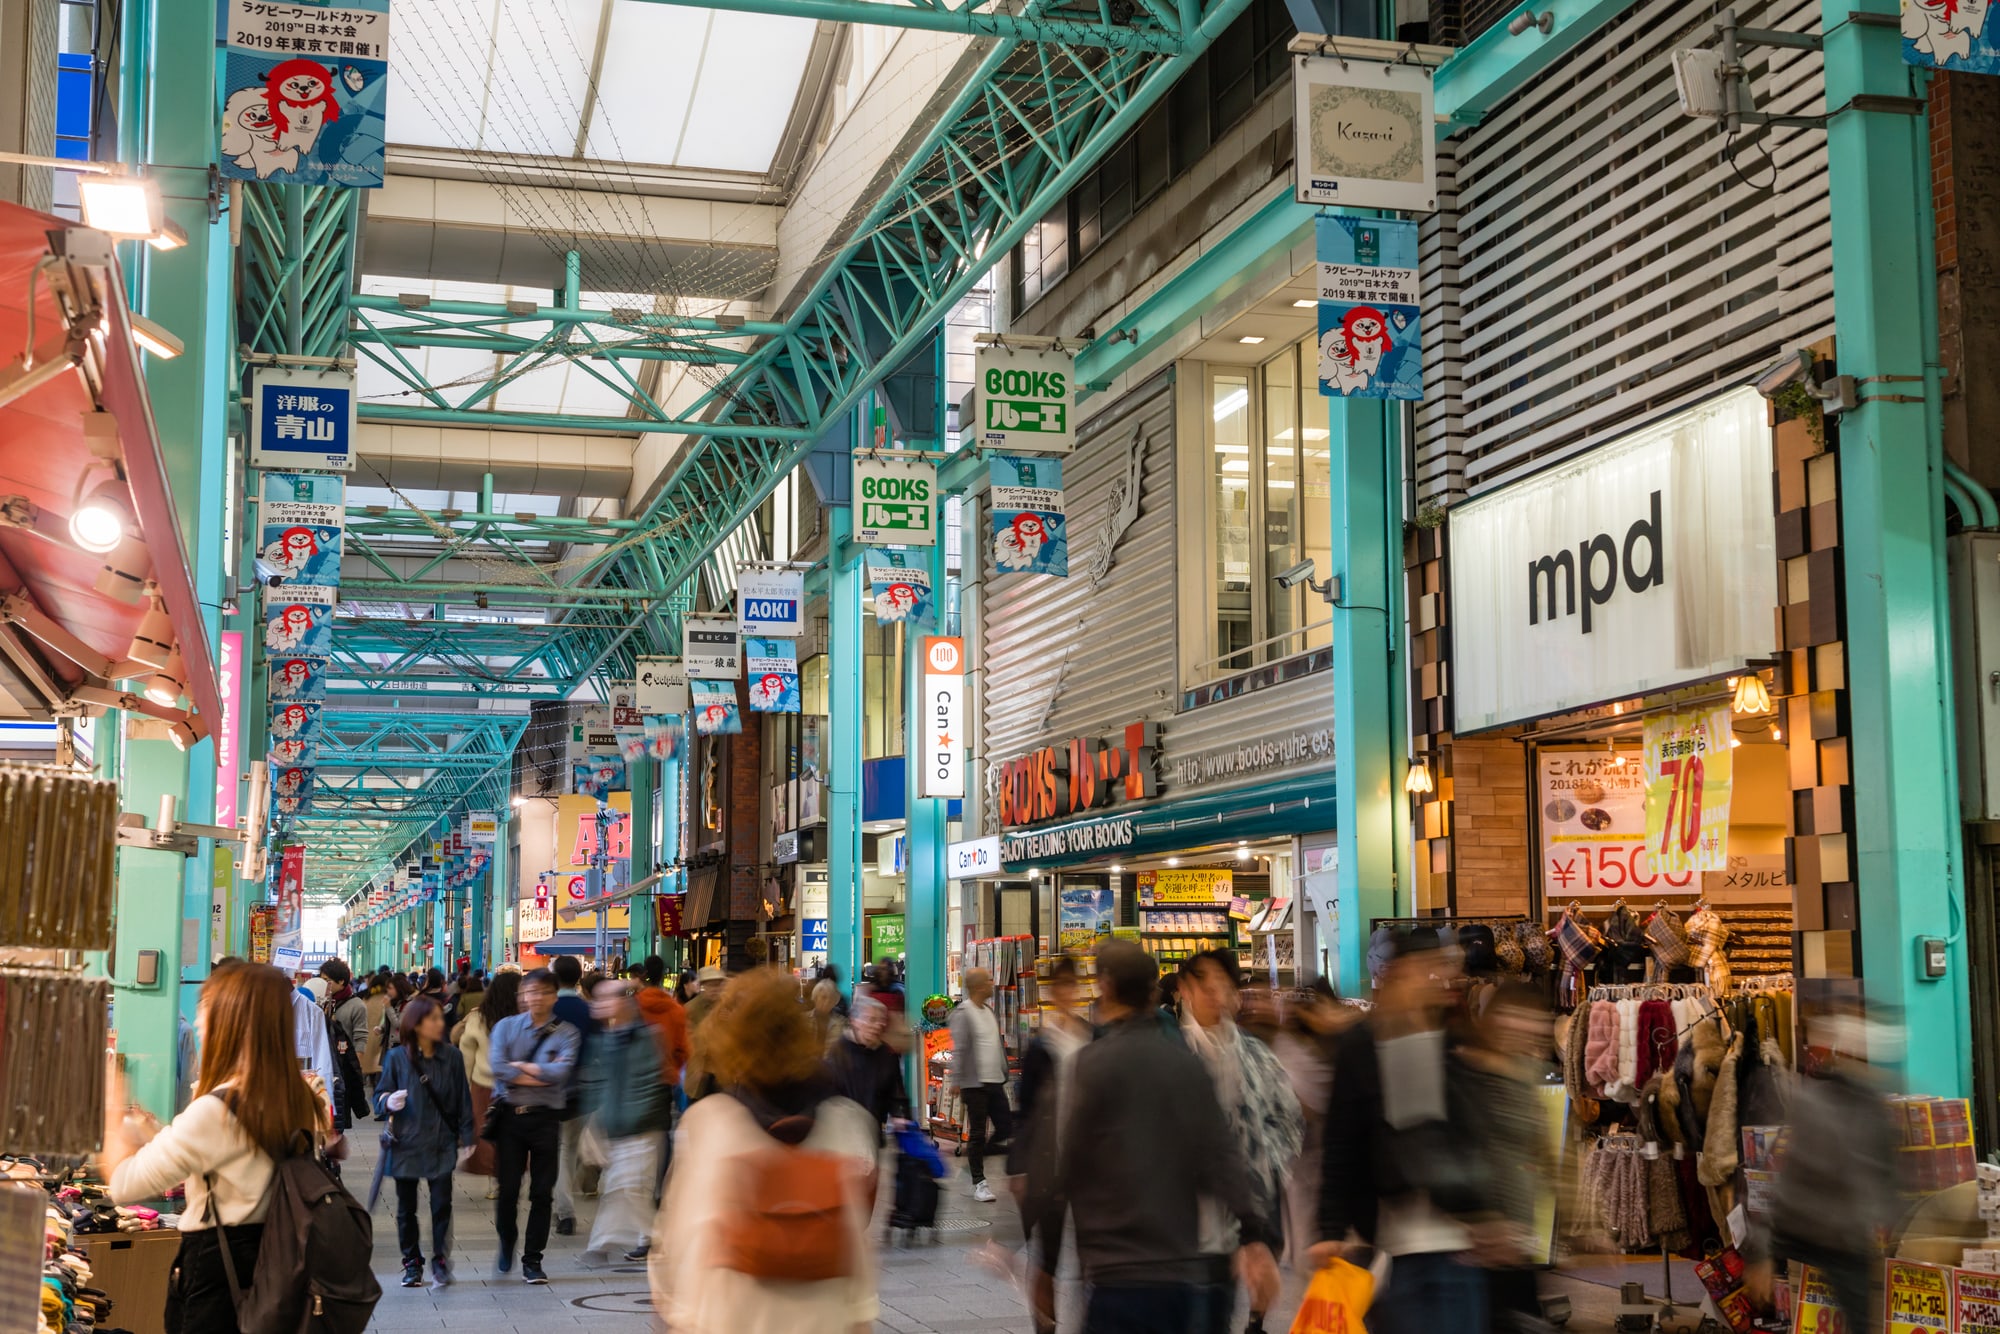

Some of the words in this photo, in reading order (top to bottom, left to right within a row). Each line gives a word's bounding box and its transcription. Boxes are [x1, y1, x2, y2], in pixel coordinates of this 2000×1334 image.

[242, 1, 378, 25] ラグビーワールドカップ
[265, 21, 358, 38] 2019™日本大会
[236, 31, 380, 57] 2019年東京で開催！
[1324, 265, 1411, 280] ラグビーワールドカップ
[1339, 278, 1400, 290] 2019™日本大会
[1322, 288, 1415, 304] 2019年東京で開催！
[985, 368, 1066, 399] BOOKS
[276, 394, 335, 413] 洋服の
[990, 401, 1061, 431] ルーエ
[274, 414, 335, 441] 青山
[862, 476, 929, 501] BOOKS
[997, 488, 1059, 497] ラグビーワールドカップ
[270, 503, 336, 511] ラグビーワールドカップ
[865, 504, 925, 529] ルーエ
[1528, 489, 1664, 635] mpd
[748, 602, 789, 619] AOKI
[936, 689, 951, 729] Can
[937, 752, 951, 780] Do
[1000, 746, 1057, 827] BOOKS
[1660, 754, 1705, 855] 70
[1000, 838, 1026, 862] ENJOY
[1026, 831, 1066, 859] READING
[1066, 825, 1095, 852] YOUR
[1094, 819, 1133, 849] BOOKS
[958, 851, 971, 869] Can
[977, 848, 988, 866] Do
[1724, 870, 1790, 888] メタルピ
